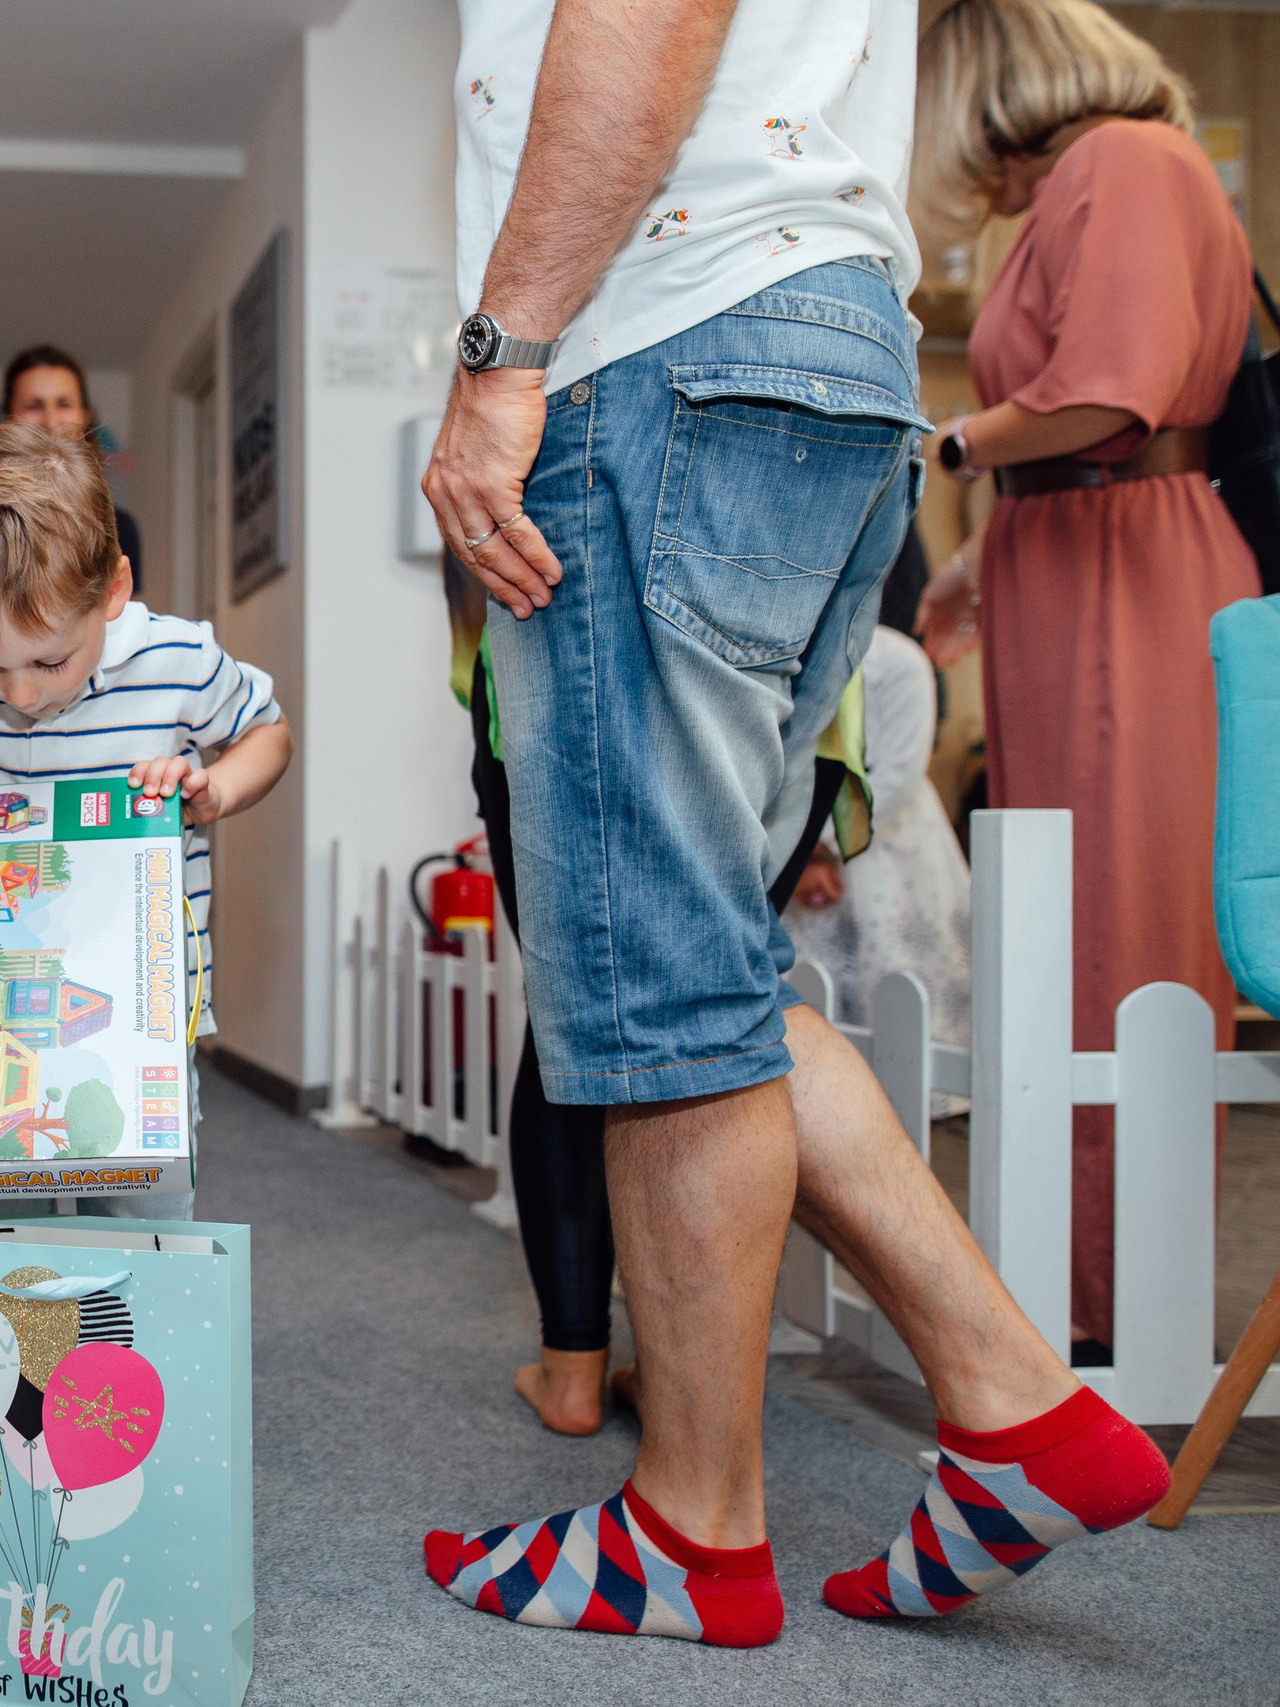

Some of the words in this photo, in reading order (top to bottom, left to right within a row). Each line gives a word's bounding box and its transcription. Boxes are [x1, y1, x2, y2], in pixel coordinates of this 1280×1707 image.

[83, 795, 94, 824] 42PCS
[135, 853, 144, 882] Enhance
[145, 848, 172, 884] MINI
[135, 883, 144, 894] the
[135, 896, 144, 934] intellectual
[146, 884, 173, 964] MAGICAL
[134, 935, 145, 981] development
[136, 982, 145, 997] and
[147, 964, 175, 1042] MAGNET
[134, 999, 146, 1032] creativity
[59, 1167, 163, 1187] MAGNET
